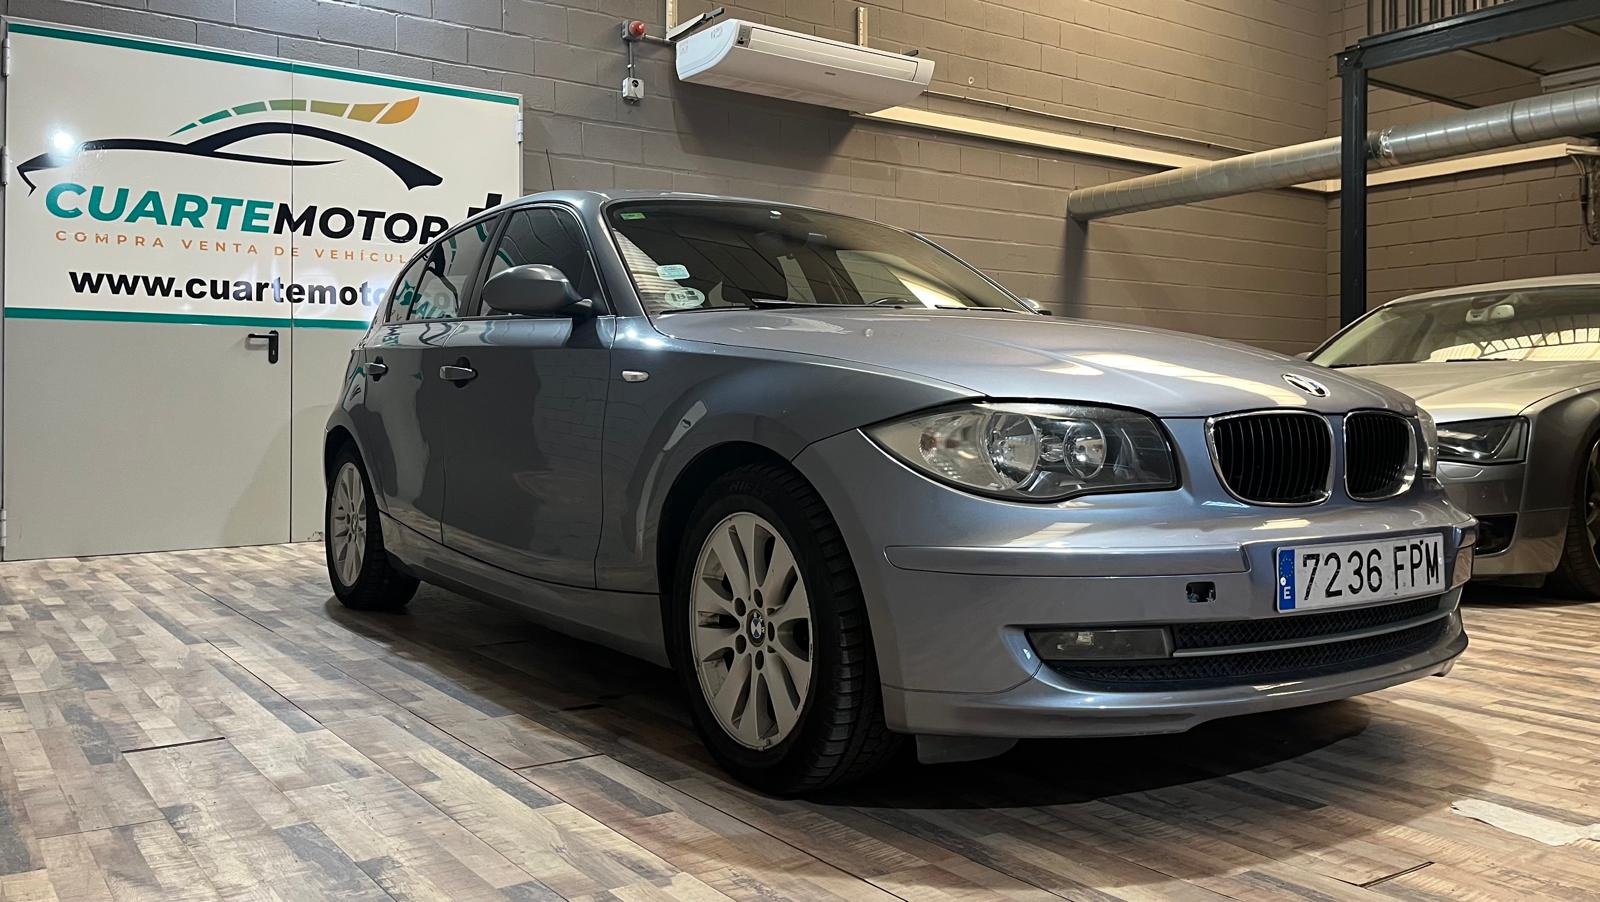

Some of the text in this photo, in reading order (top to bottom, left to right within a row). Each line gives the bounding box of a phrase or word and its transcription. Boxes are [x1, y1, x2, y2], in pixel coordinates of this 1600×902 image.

[55, 230, 164, 248] COMPRA
[181, 239, 258, 255] VENTA
[274, 246, 299, 257] DE
[1302, 540, 1440, 601] 7236 FPM
[1283, 586, 1292, 600] E
